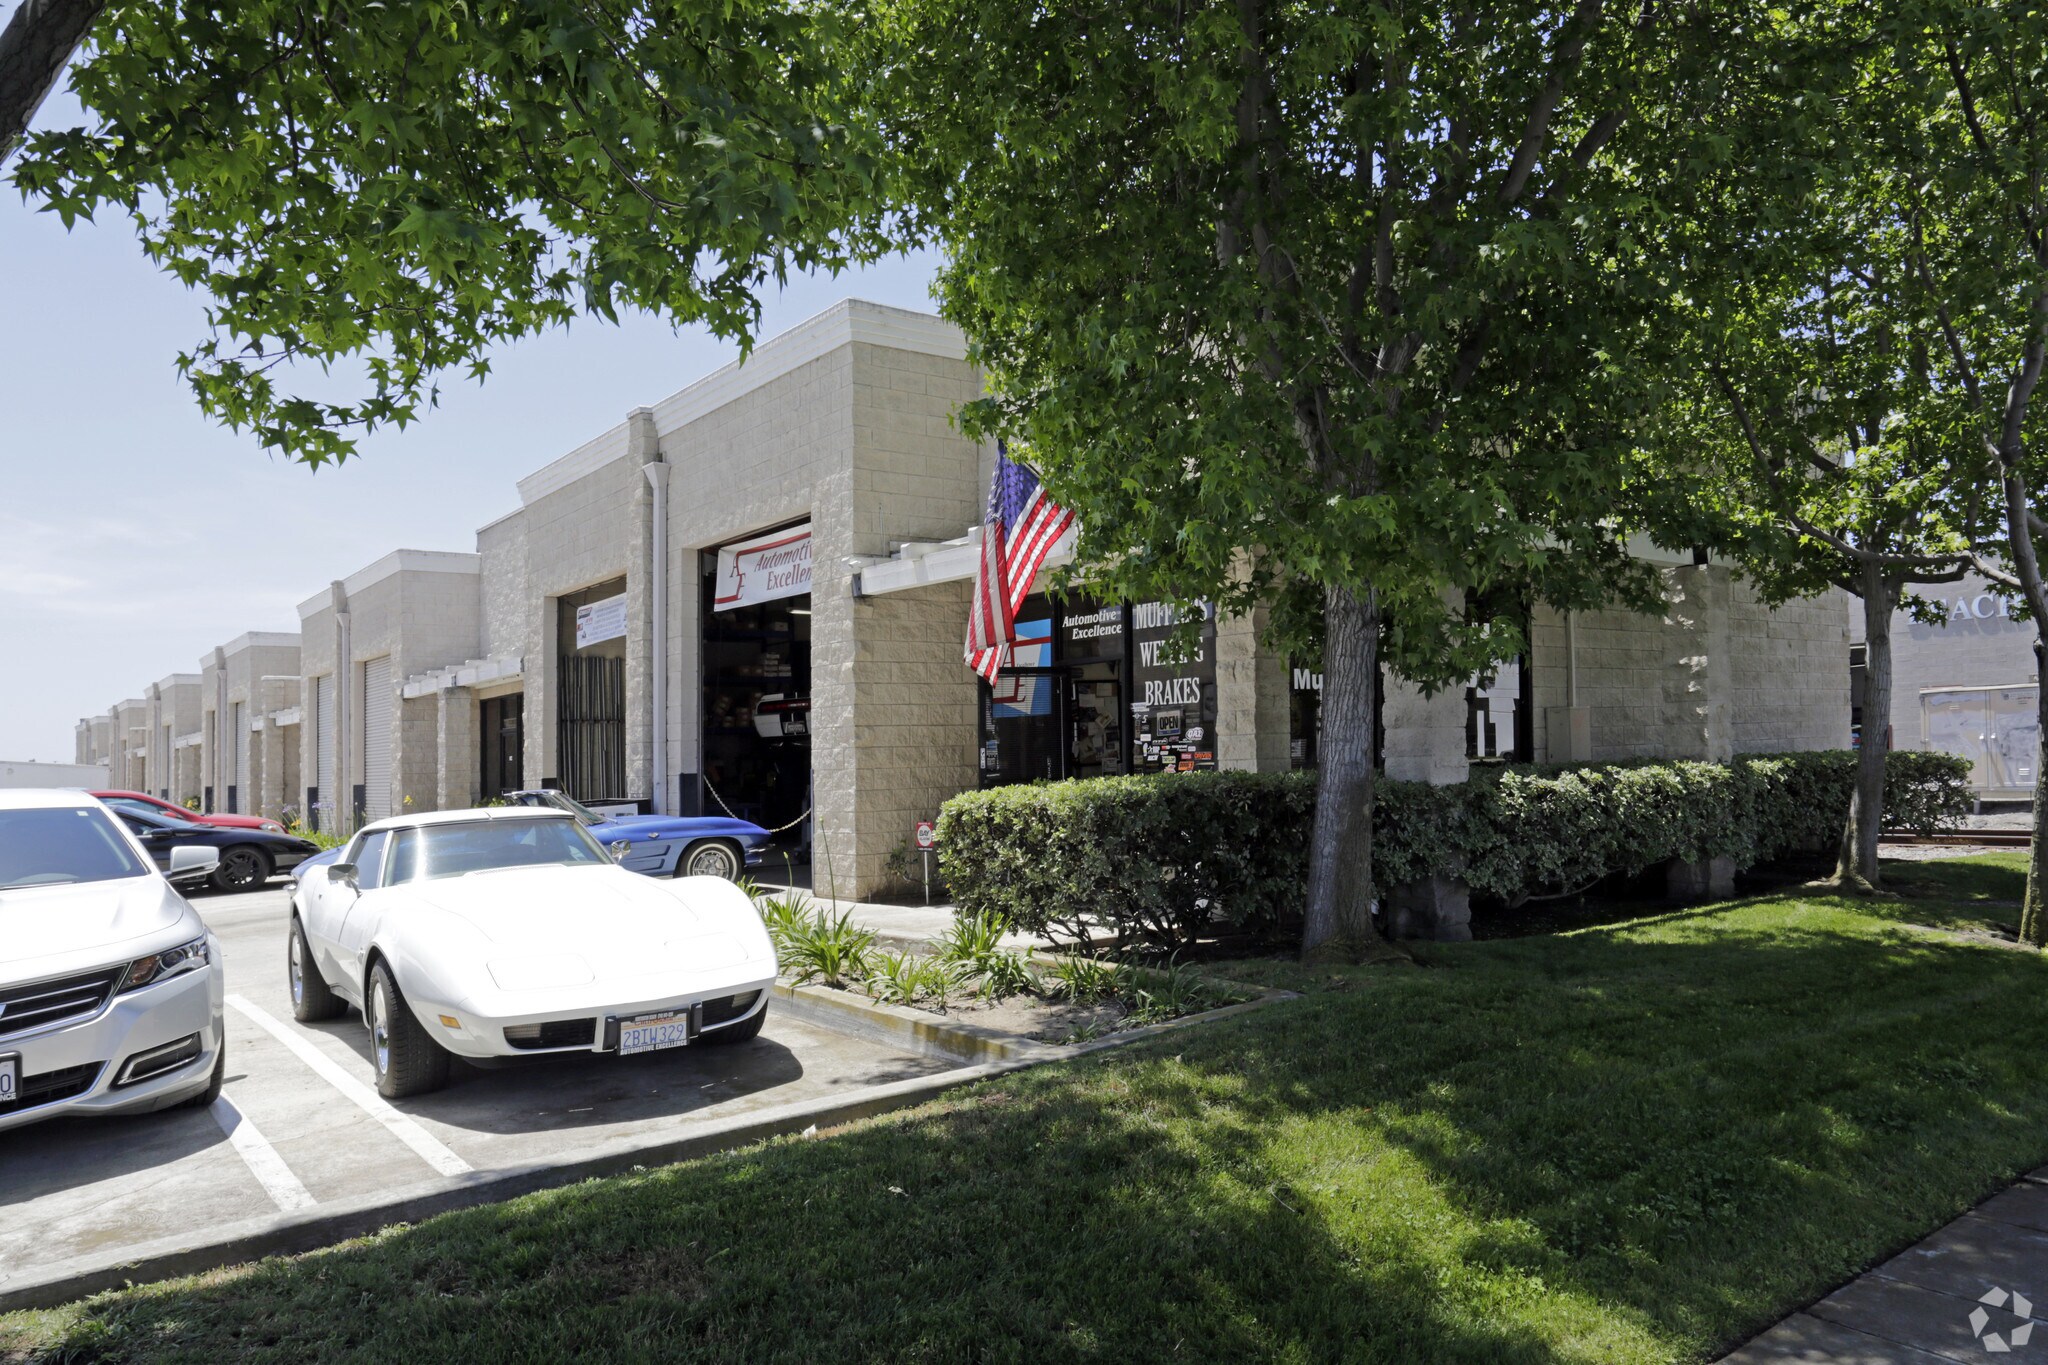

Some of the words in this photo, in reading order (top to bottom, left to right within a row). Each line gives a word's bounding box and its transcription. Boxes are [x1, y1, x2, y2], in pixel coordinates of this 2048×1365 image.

[1062, 610, 1116, 628] Automotive
[1072, 624, 1122, 640] Excellence
[1145, 677, 1200, 706] BRAKES
[1159, 715, 1179, 731] OPEN
[623, 1023, 684, 1049] 2BIW329
[620, 1044, 655, 1056] AUTOMOTIVE
[655, 1039, 687, 1050] EXCELLENCE
